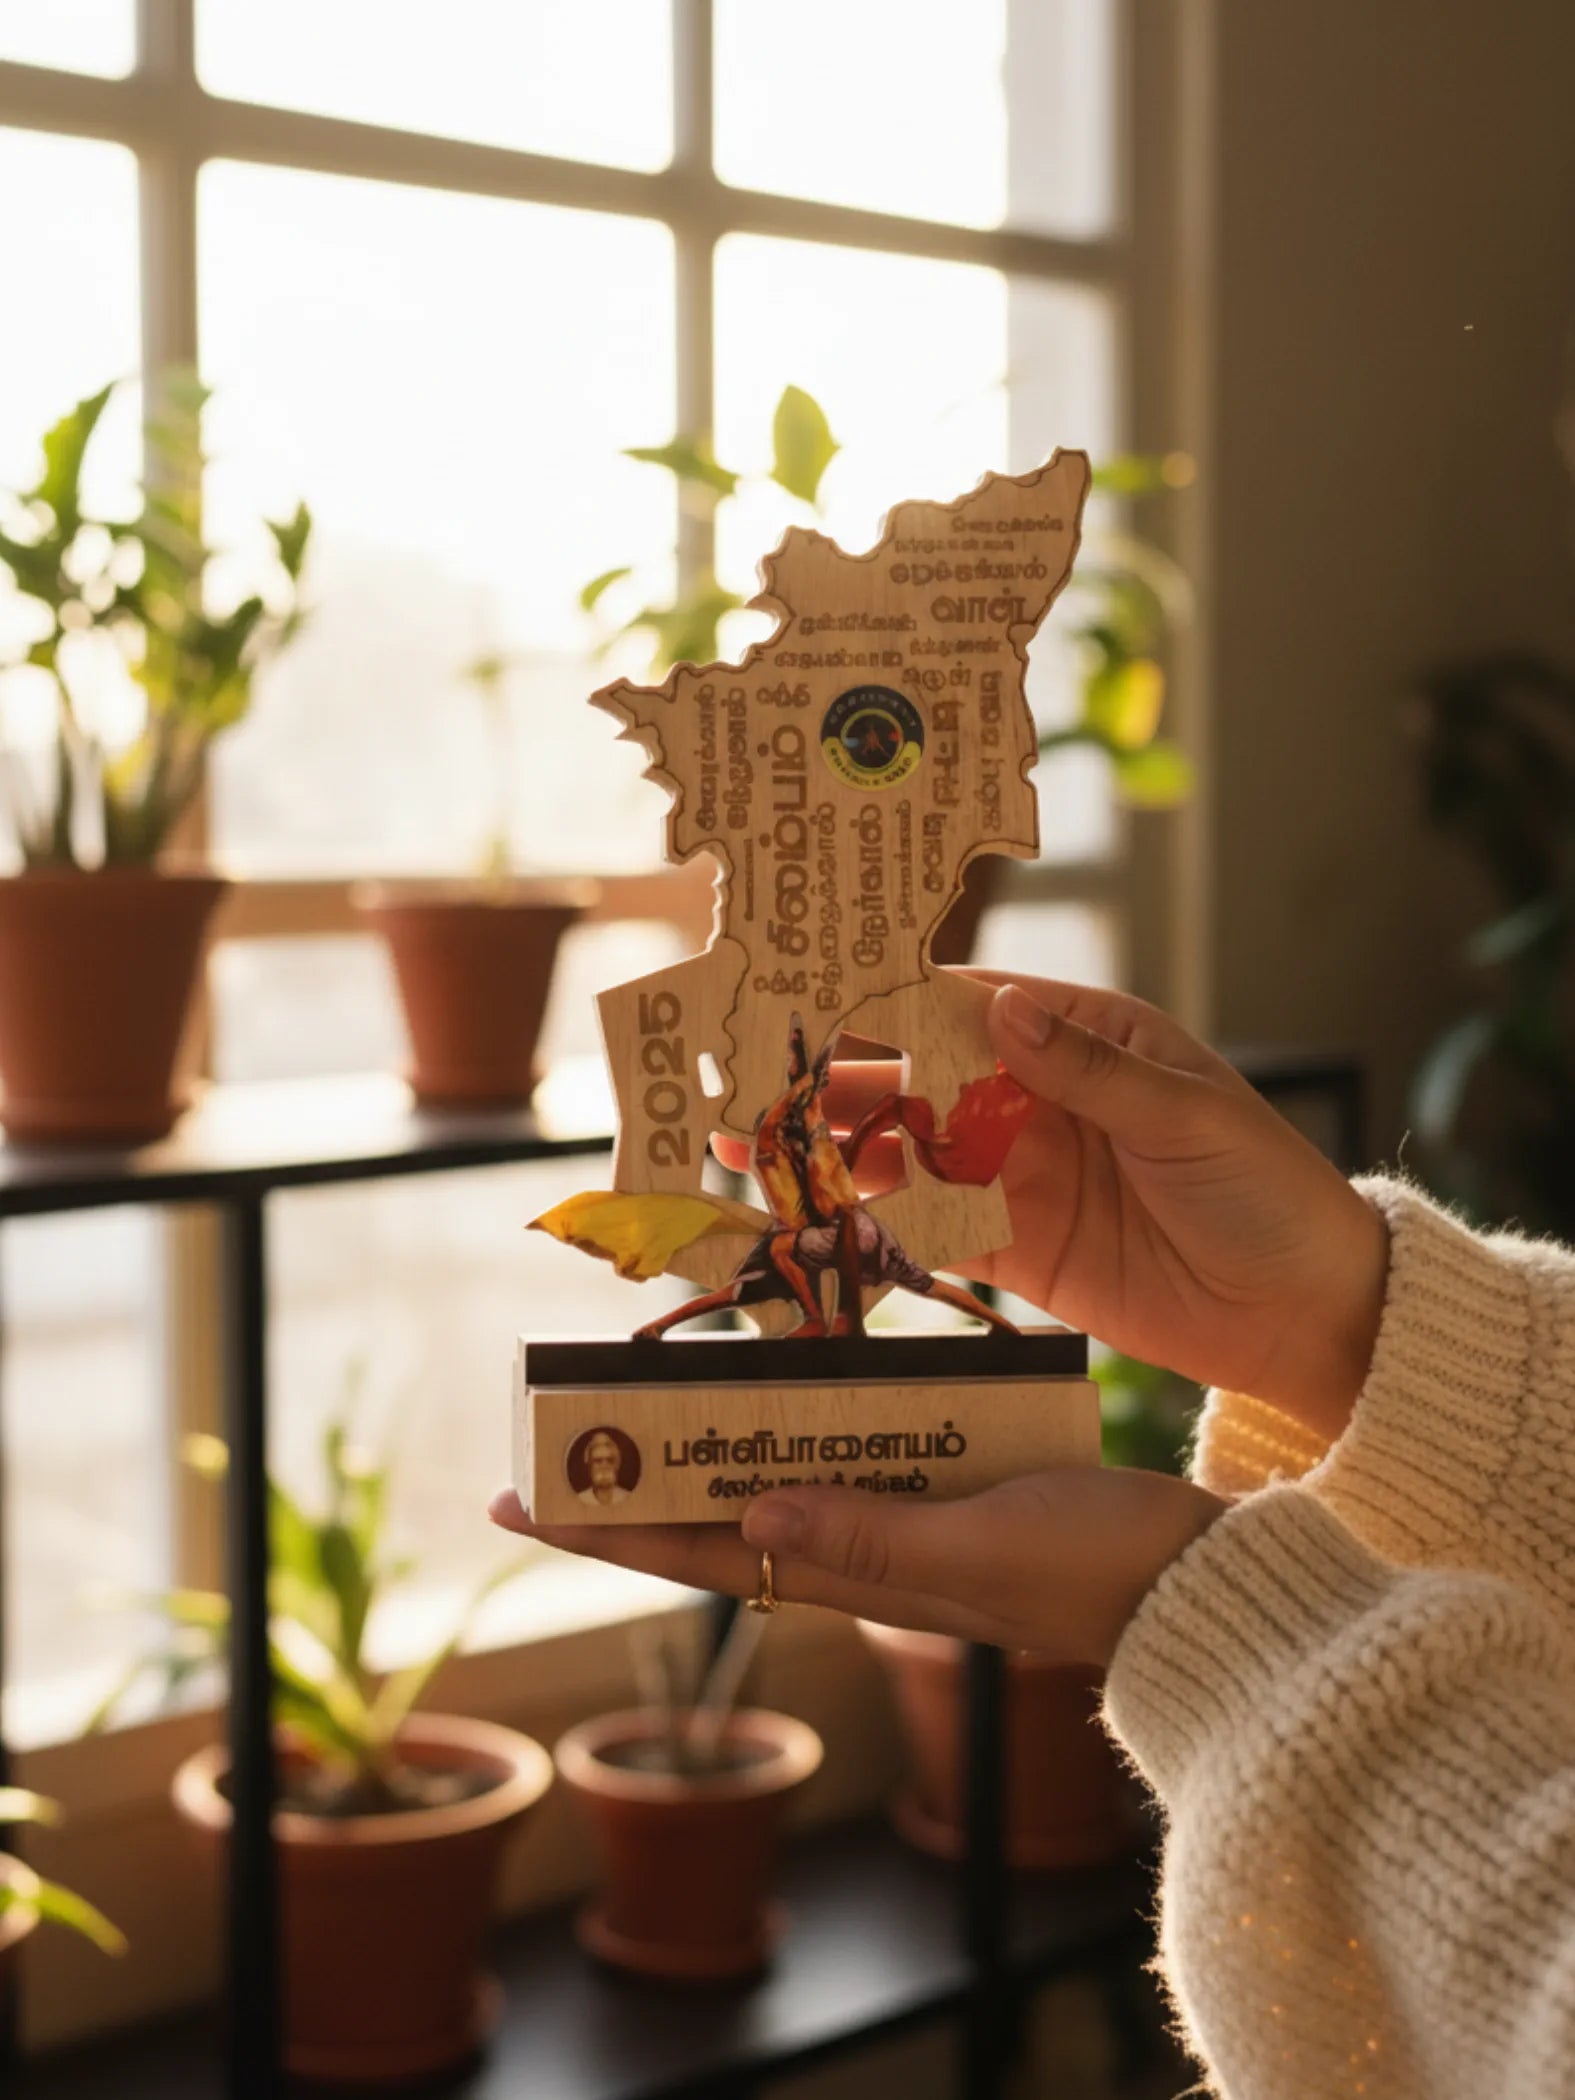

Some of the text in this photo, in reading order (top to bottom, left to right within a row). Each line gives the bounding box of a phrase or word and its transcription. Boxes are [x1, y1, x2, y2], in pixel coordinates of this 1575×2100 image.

[757, 724, 810, 957] சிலம்பம்
[637, 990, 691, 1168] 2025
[663, 1420, 968, 1467] பள்ளிபாளையம்
